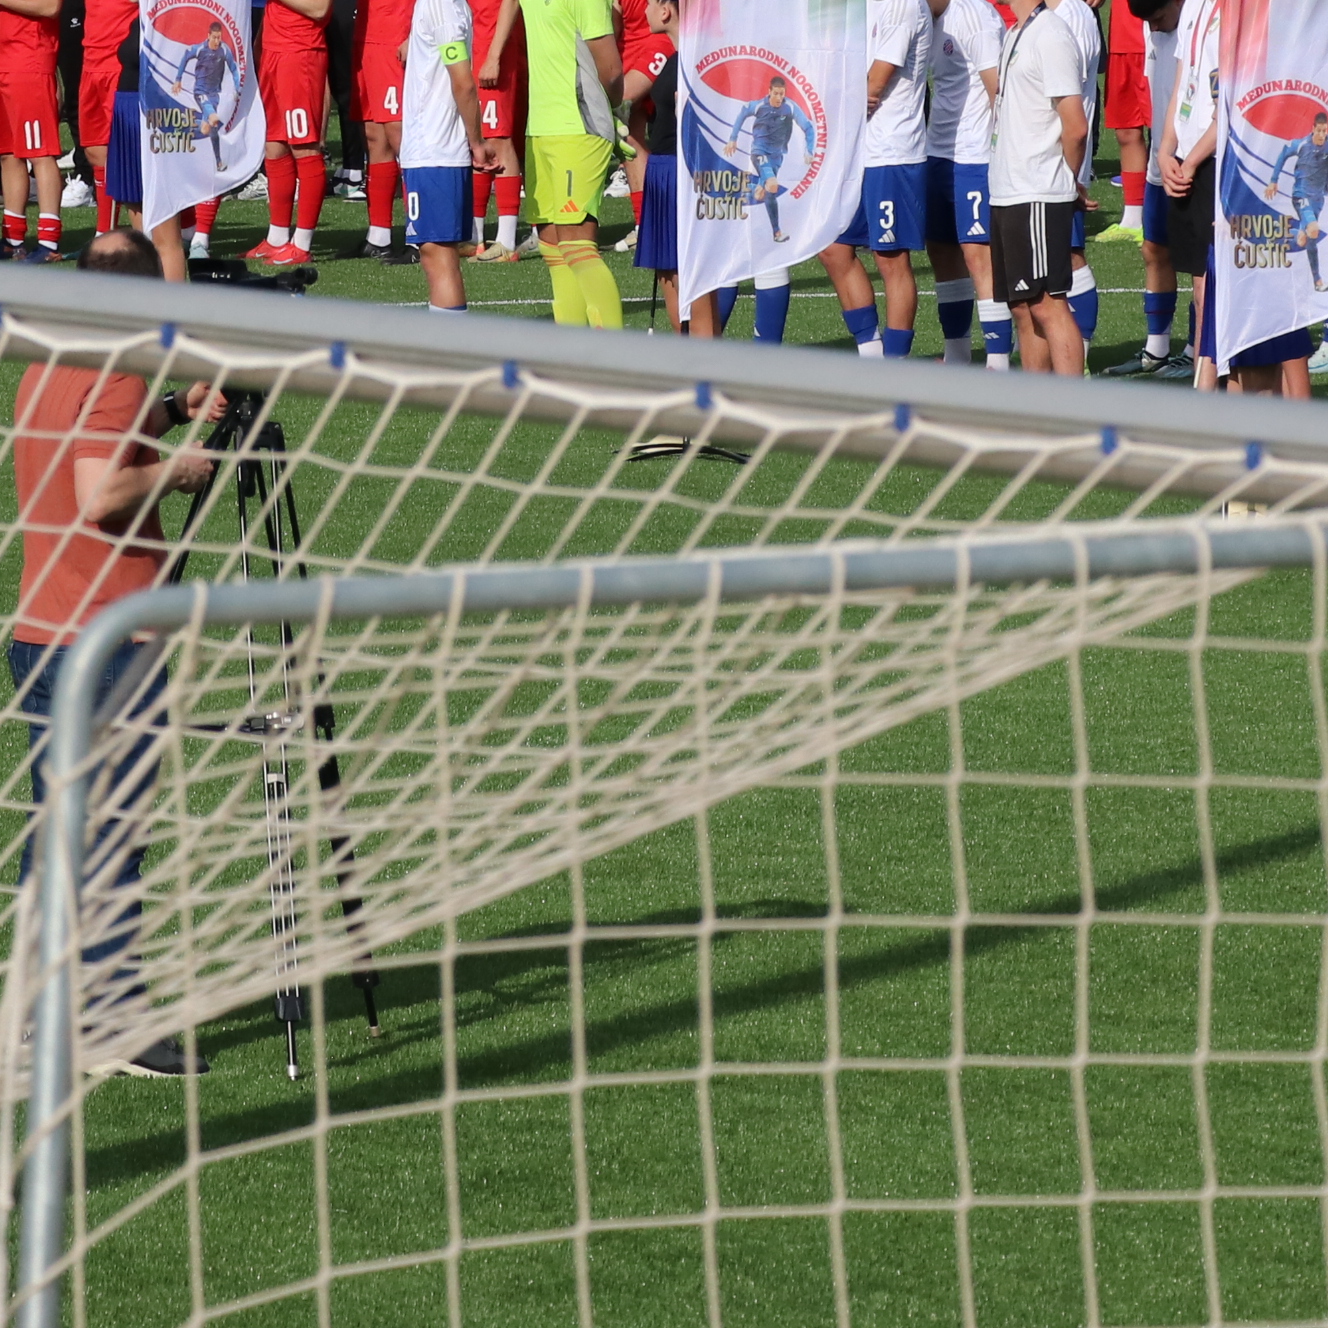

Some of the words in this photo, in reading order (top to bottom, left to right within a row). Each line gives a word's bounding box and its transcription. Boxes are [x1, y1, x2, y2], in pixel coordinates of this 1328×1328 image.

[445, 45, 459, 60] C
[648, 52, 669, 77] 3
[383, 86, 399, 115] 4
[786, 66, 829, 150] NOGOMETNI
[146, 107, 199, 130] HRVOJE
[285, 108, 309, 139] 10
[479, 100, 499, 134] 4
[24, 119, 41, 150] 11
[565, 170, 573, 198] 1
[693, 170, 753, 194] HRVOJE
[789, 151, 826, 200] TURNIR
[879, 200, 895, 230] 3
[967, 191, 983, 220] 7
[1229, 214, 1295, 240] HRVOJE
